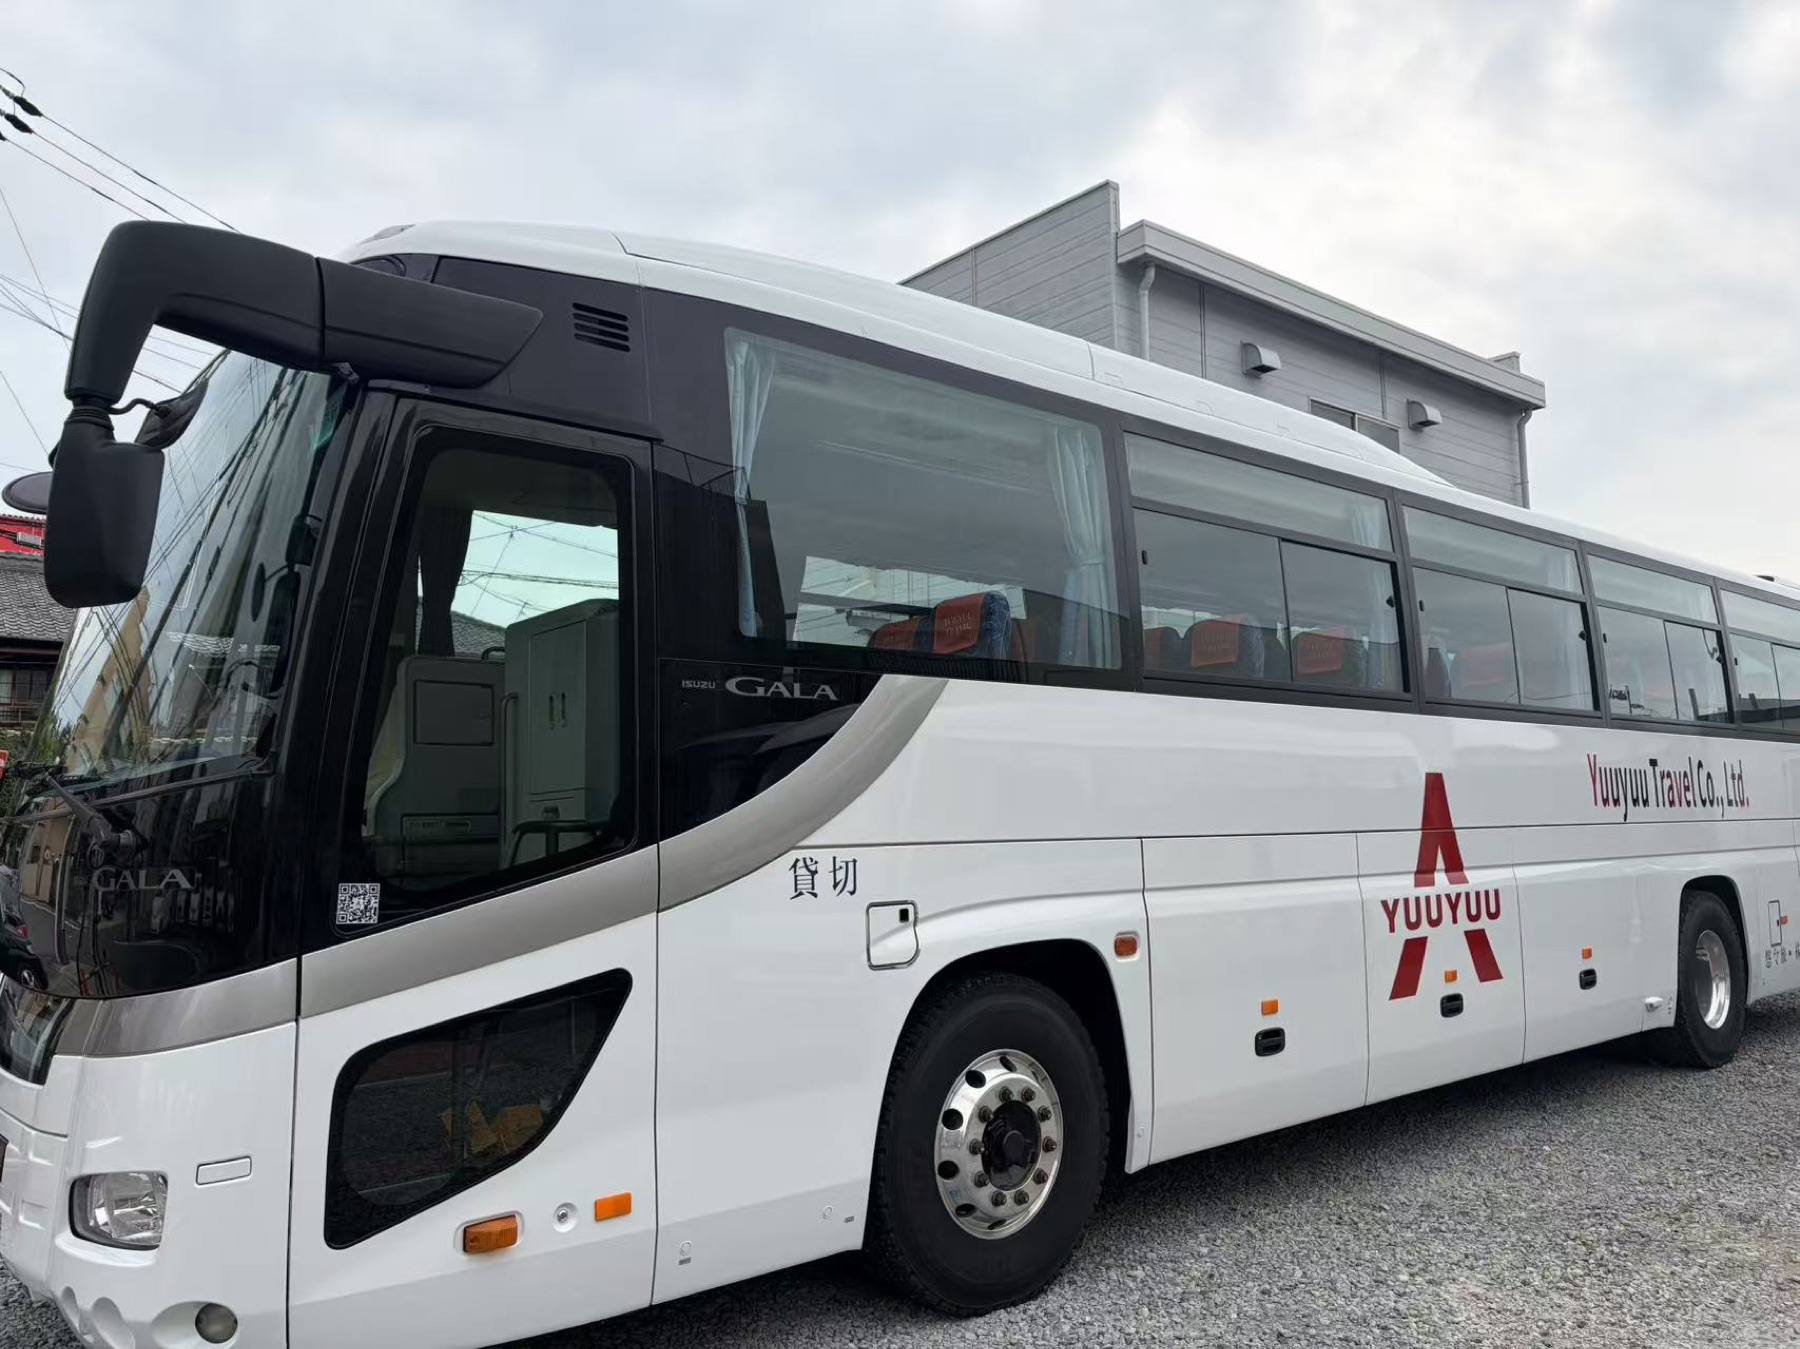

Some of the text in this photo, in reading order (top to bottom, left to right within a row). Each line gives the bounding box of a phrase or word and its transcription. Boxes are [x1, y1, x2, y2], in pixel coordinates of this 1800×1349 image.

[681, 676, 838, 700] ISUZU GALA
[1587, 753, 1749, 822] Yuuyuu Travel Co., Ltd.
[92, 865, 194, 891] GALA
[788, 855, 858, 900] 貸切
[1381, 888, 1502, 934] YUUYUU
